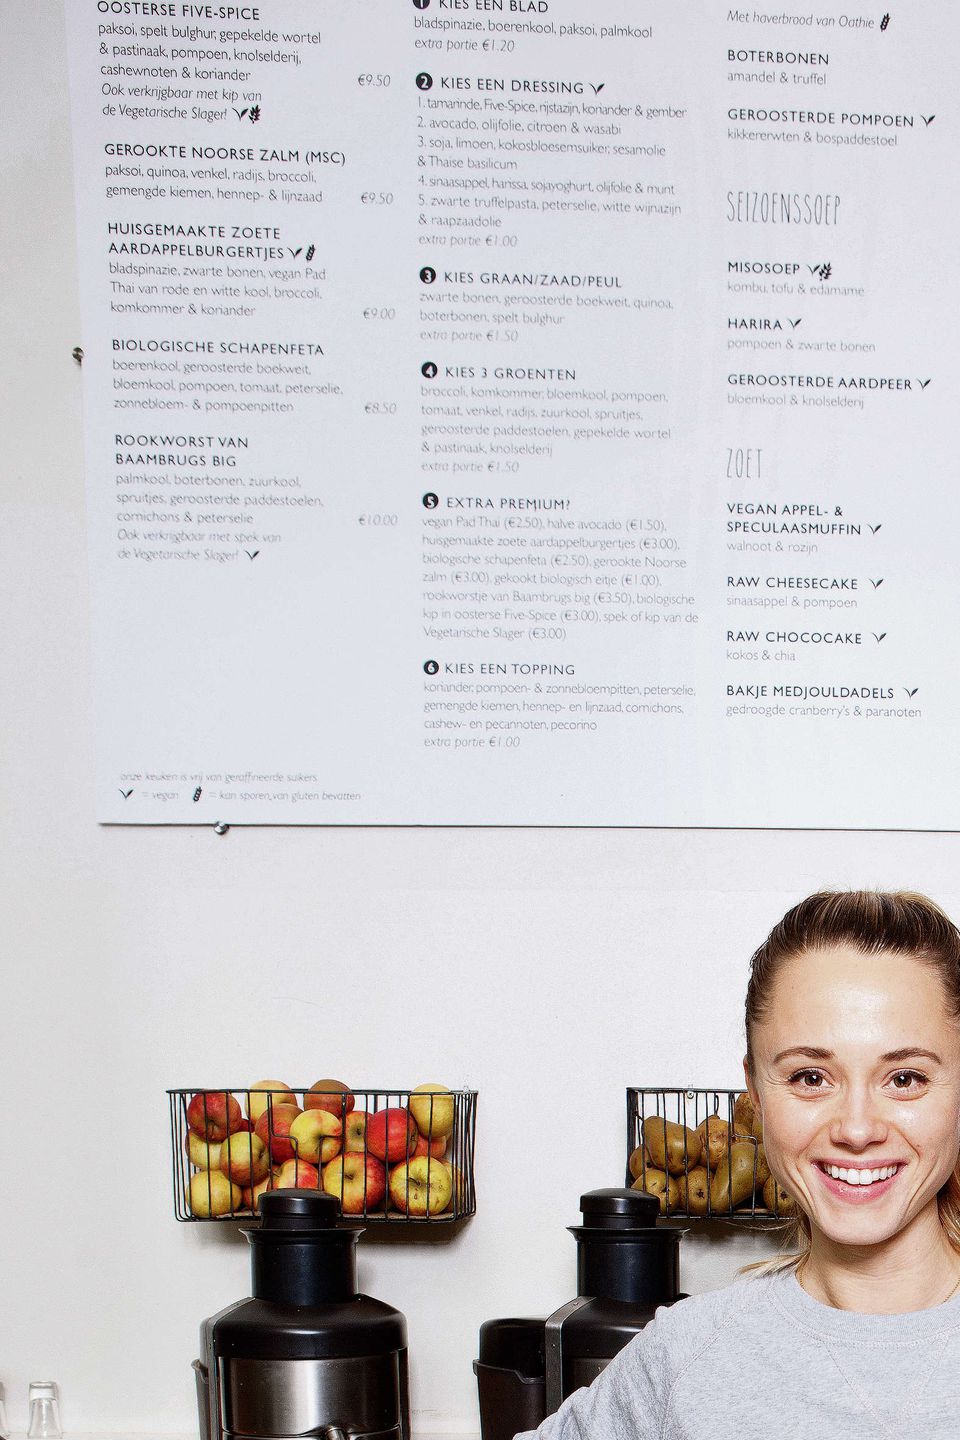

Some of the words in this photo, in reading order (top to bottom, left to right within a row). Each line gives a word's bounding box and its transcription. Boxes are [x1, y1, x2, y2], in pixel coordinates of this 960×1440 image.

[97, 0, 177, 17] OOSTERSE
[182, 4, 260, 21] FIVE-SPICE
[439, 0, 470, 10] KIES
[475, 0, 503, 12] EEN
[509, 0, 549, 13] BLAD
[98, 21, 138, 39] paksoi,
[140, 23, 169, 40] spelt
[169, 24, 217, 42] bulghur,
[219, 28, 279, 45] gepekelde
[281, 31, 321, 45] wortel
[413, 15, 486, 33] bladspinazie,
[487, 18, 557, 35] boerenkool,
[559, 22, 598, 37] paksoi,
[600, 24, 653, 39] palmkool
[727, 49, 829, 66] BOTERBONEN
[357, 73, 391, 88] €9.50
[440, 76, 471, 90] KIES
[477, 78, 505, 91] EEN
[511, 79, 584, 95] DRESSING
[727, 69, 776, 84] amandel
[779, 71, 789, 85] &
[792, 72, 827, 86] truffel
[727, 108, 835, 125] GEROOSTERDE
[841, 112, 914, 128] POMPOEN
[104, 143, 187, 159] GEROOKTE
[191, 146, 255, 161] NOORSE
[259, 148, 300, 163] ZALM
[305, 151, 346, 167] (MSC)
[726, 191, 841, 226] SEIZOENSSOEP
[107, 222, 226, 238] HUISGEMAAKTE
[231, 226, 281, 240] ZOETE
[108, 242, 284, 262] AARDAPPELBURGERTJES
[728, 261, 800, 275] MISOSOEP
[444, 271, 474, 284] KIES
[479, 272, 622, 289] GRAAN/ZAAD/PEUL
[728, 317, 783, 331] HARIRA
[112, 338, 214, 354] BIOLOGISCHE
[219, 341, 325, 356] SCHAPENFETA
[445, 366, 475, 379] KIES
[481, 367, 488, 379] 3
[494, 367, 576, 381] GROENTEN
[727, 373, 834, 388] GEROOSTERDE
[837, 377, 912, 390] AARDPEER
[115, 434, 215, 448] ROOKWORST
[217, 436, 249, 449] VAN
[115, 453, 207, 467] BAAMBRUGS
[212, 455, 237, 467] BIG
[726, 447, 763, 480] ZOET
[446, 496, 495, 509] EXTRA
[500, 497, 571, 512] PREMIUM?
[726, 503, 777, 515] VEGAN
[781, 504, 829, 517] APPEL-
[834, 505, 843, 517] &
[727, 521, 861, 536] SPECULAASMUFFIN
[727, 576, 760, 588] RAW
[765, 576, 858, 590] CHEESECAKE
[726, 630, 760, 642] RAW
[765, 631, 862, 645] CHOCOCAKE
[445, 663, 475, 675] KIES
[480, 663, 507, 675] EEN
[511, 663, 575, 676] TOPPING
[726, 684, 768, 700] BAKJE
[773, 685, 894, 701] MEDJOULDADELS
